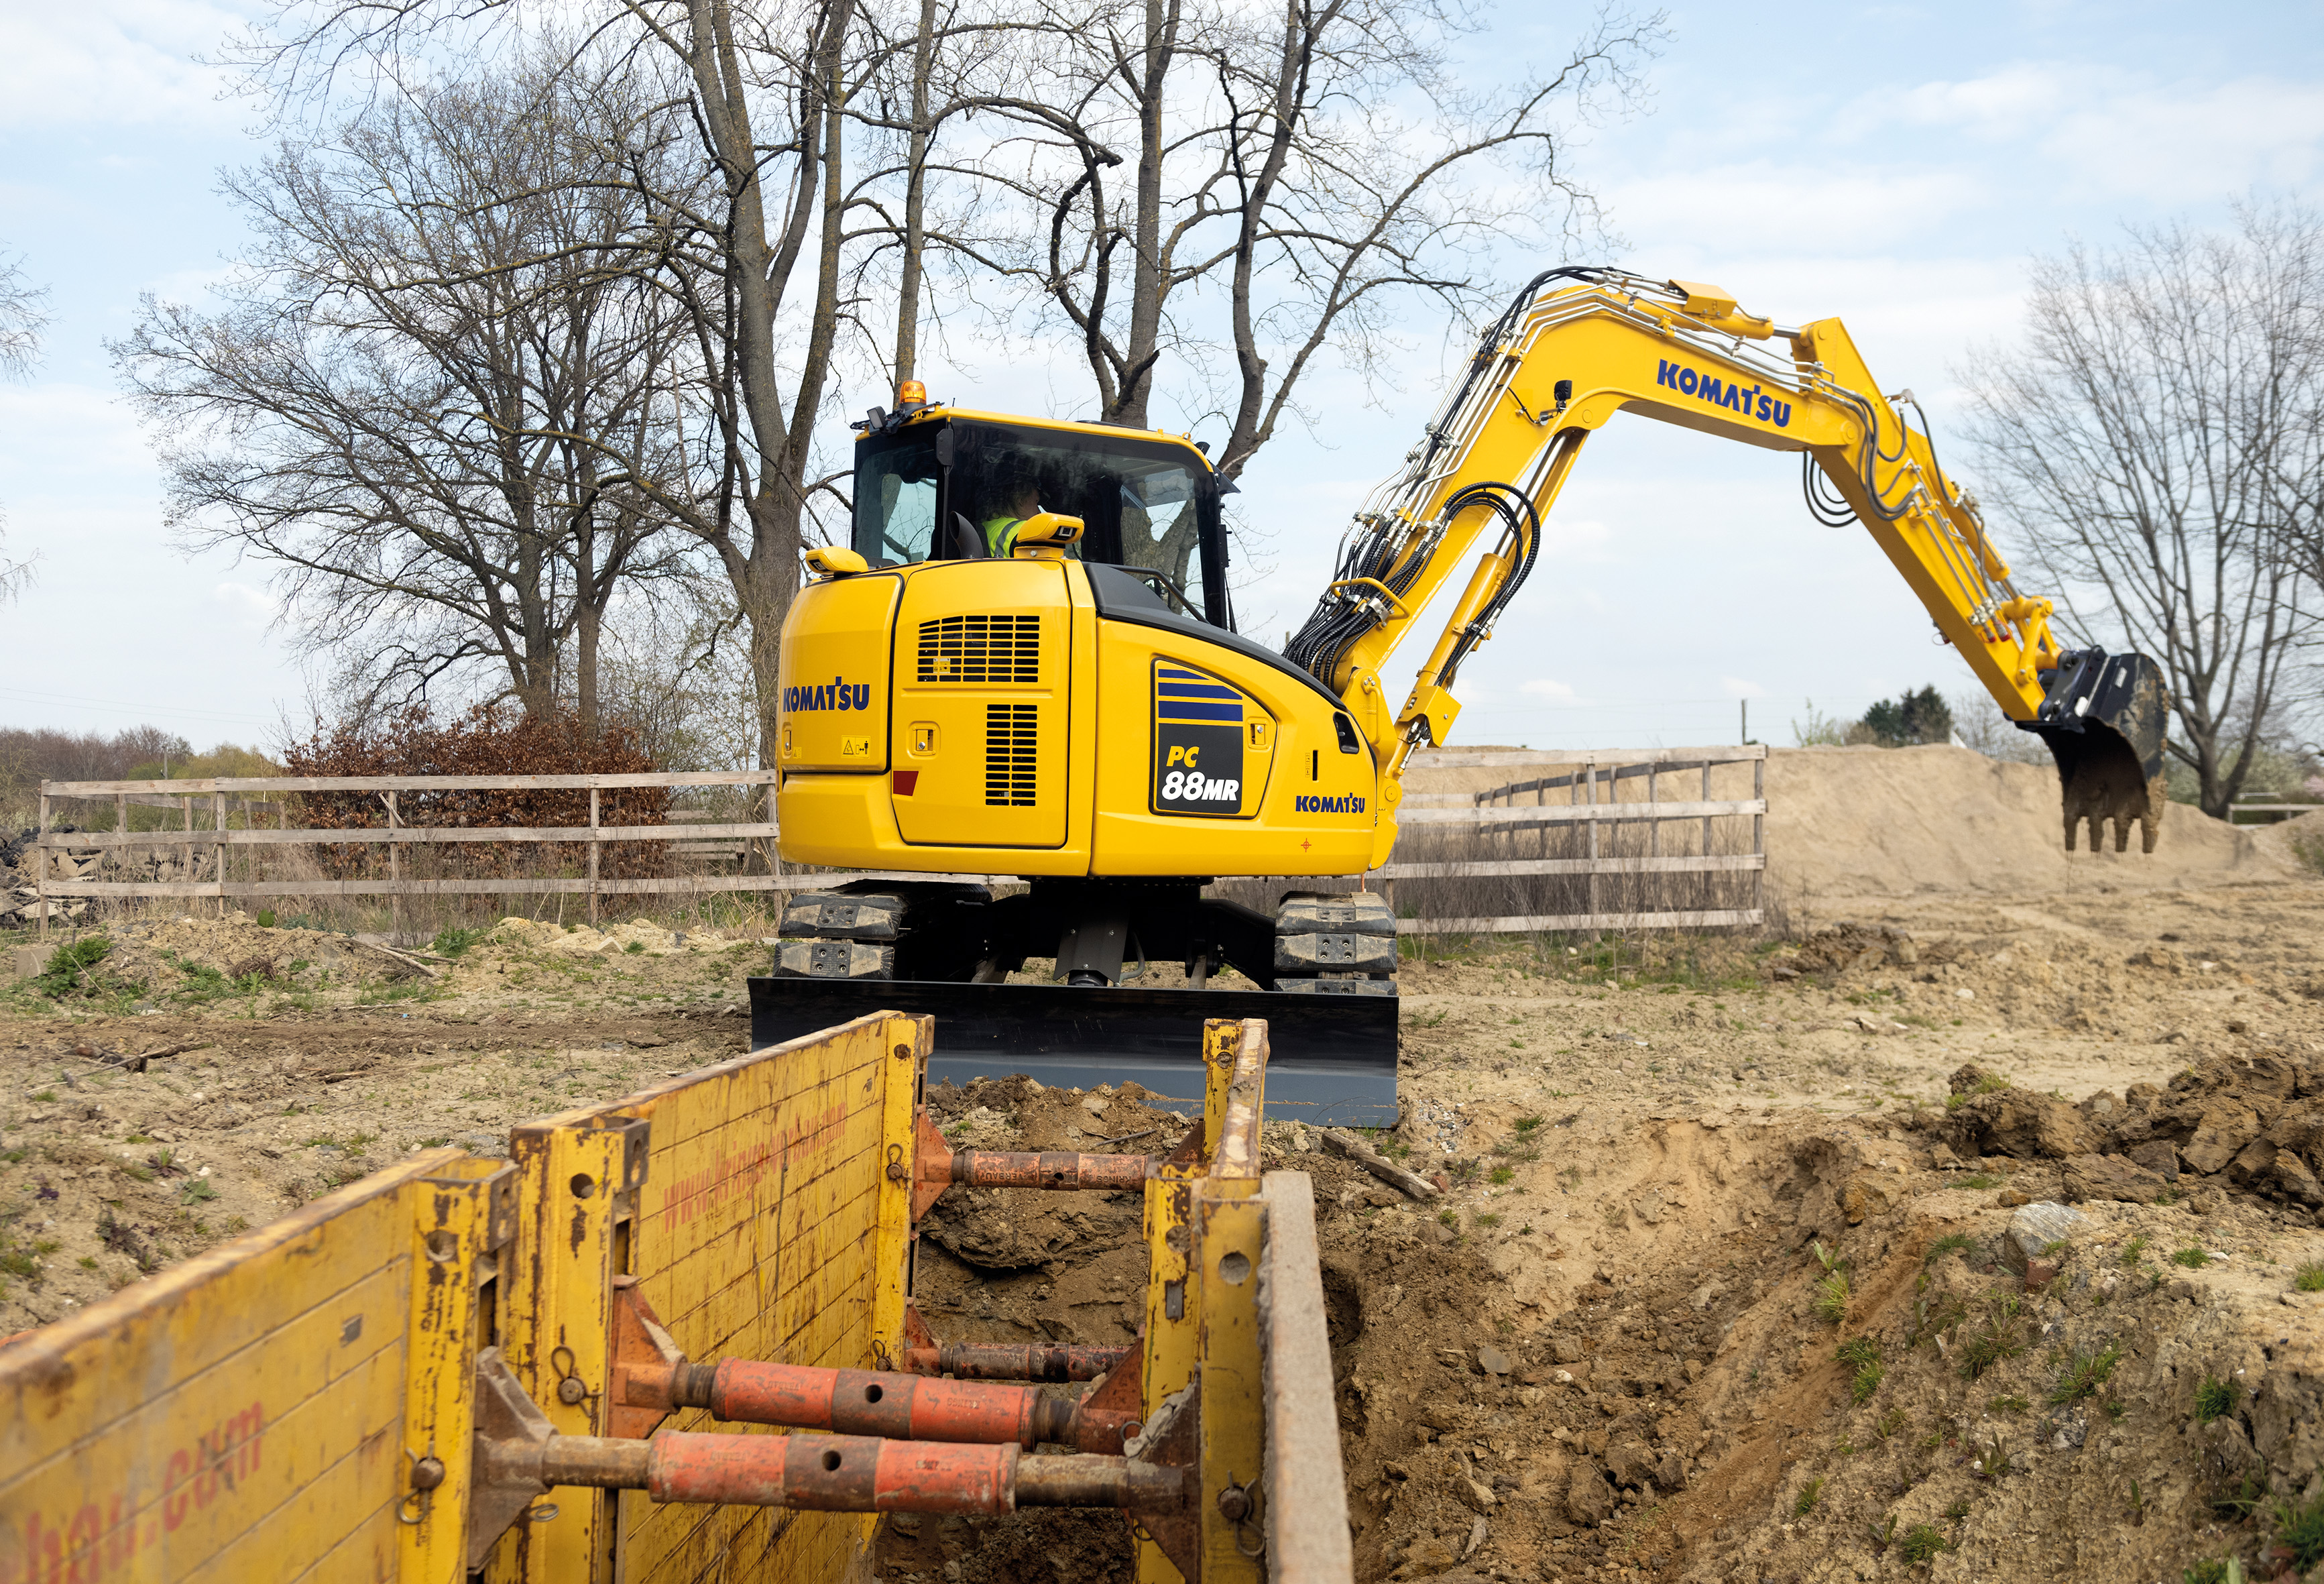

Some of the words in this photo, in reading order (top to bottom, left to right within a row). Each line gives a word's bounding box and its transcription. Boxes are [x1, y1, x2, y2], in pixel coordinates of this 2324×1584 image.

[1657, 359, 1792, 428] KOMATSU
[782, 676, 870, 712] KOMATSU
[1166, 746, 1200, 768] PC
[1161, 771, 1240, 801] 88MR
[1295, 792, 1366, 813] KOMATSU
